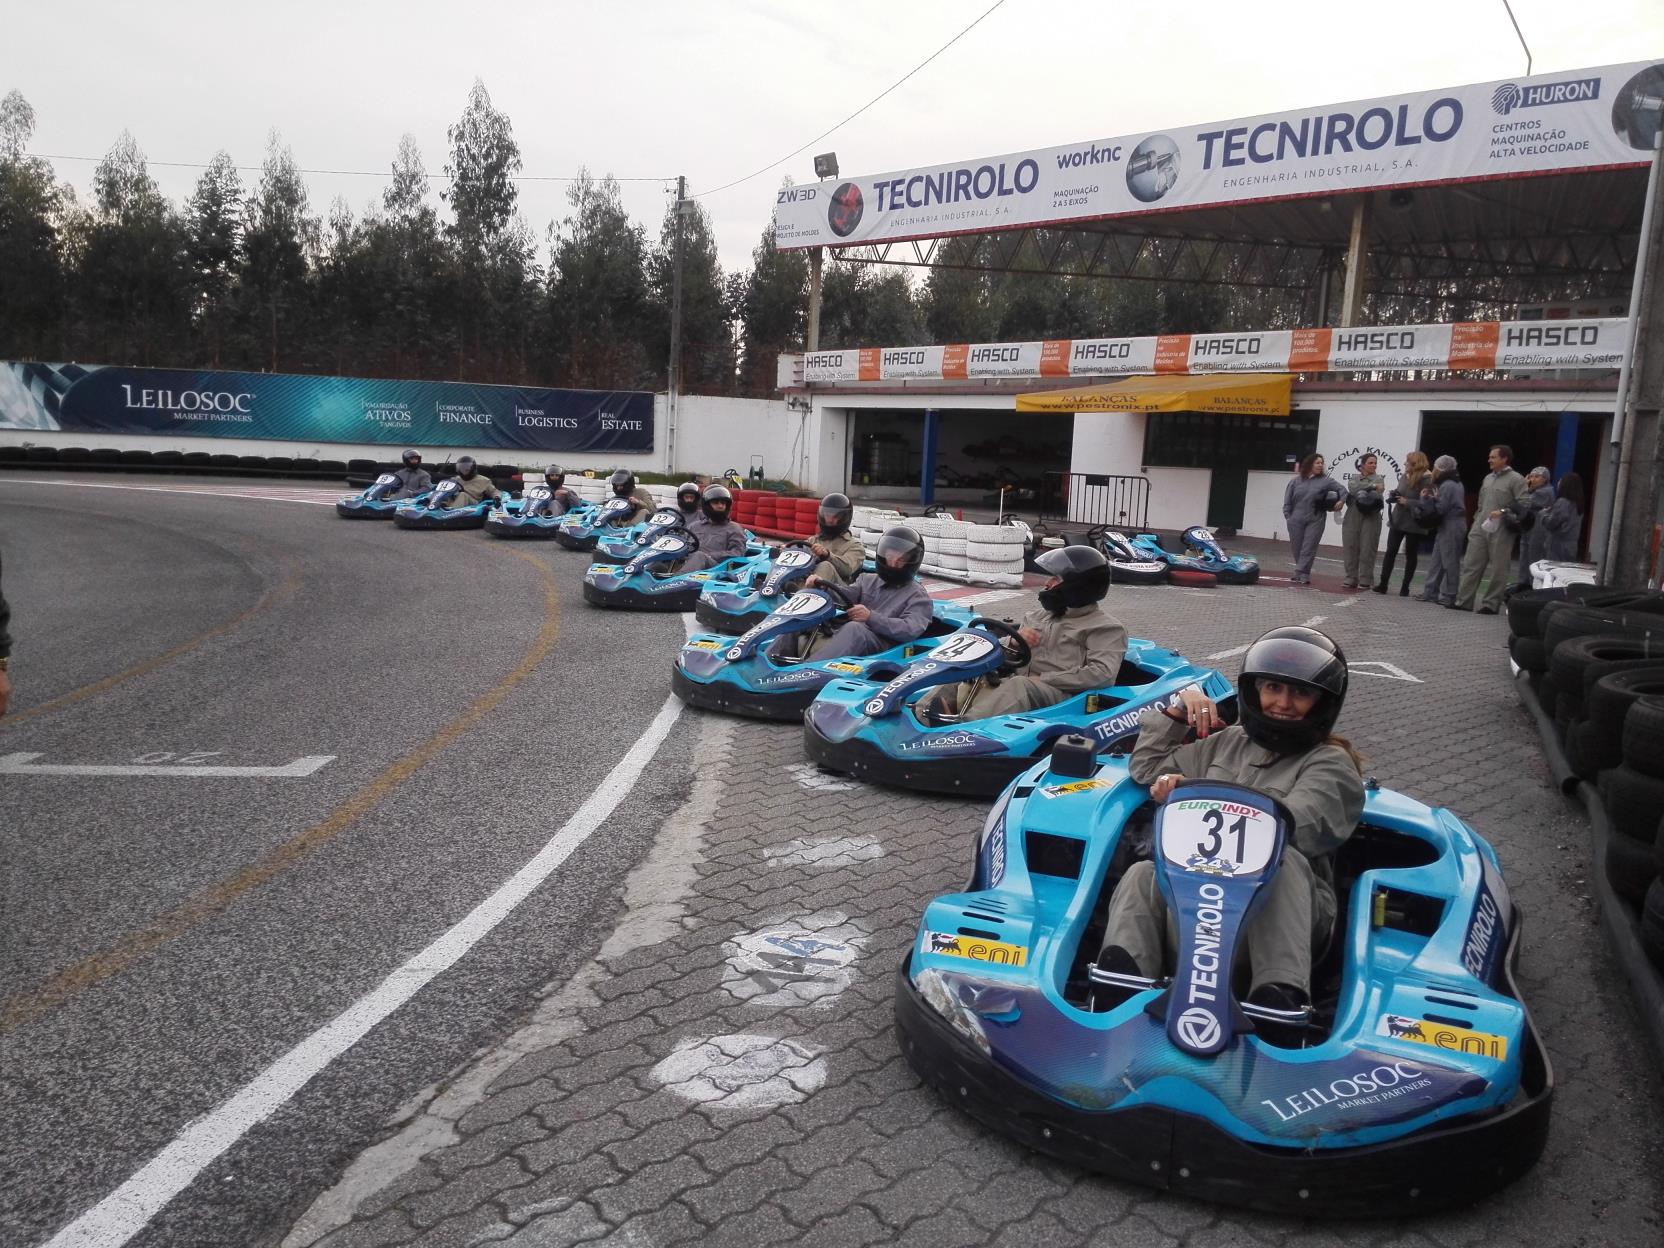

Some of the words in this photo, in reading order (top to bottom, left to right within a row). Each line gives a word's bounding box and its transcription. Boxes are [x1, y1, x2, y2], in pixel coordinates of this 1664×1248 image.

[1527, 81, 1594, 104] HURON
[1197, 97, 1464, 170] TECNIROLO
[1492, 119, 1541, 133] CENTROS
[1491, 129, 1566, 146] MAQUINAÇÃO
[1489, 148, 1516, 159] ALTA
[1518, 140, 1590, 155] VELOCIDADE
[1223, 171, 1298, 188] ENGENHARIA
[1303, 163, 1386, 180] INDUSTRIAL,
[873, 158, 1040, 212] TECNIROLO
[1053, 185, 1099, 198] MAQUINAÇÃO
[777, 188, 817, 204] ZW3D
[1068, 197, 1088, 206] EIXOS
[890, 215, 939, 228] ENGENHARIA
[941, 208, 993, 222] INDUSTRIAL,
[1337, 331, 1415, 352] HASCO
[1506, 326, 1599, 347] HASCO
[971, 347, 1020, 363] HASCO
[1074, 343, 1131, 360] HASCO
[1194, 337, 1262, 356] HASCO
[806, 355, 843, 369] HASCO
[884, 351, 925, 366] HASCO
[1193, 362, 1228, 371] Enabling
[1230, 361, 1248, 370] with
[1335, 357, 1376, 368] Enabling
[1378, 357, 1400, 367] with
[1503, 354, 1553, 366] Enabling
[1555, 354, 1579, 365] with
[1103, 365, 1119, 373] with
[121, 384, 252, 413] LEILOSOC
[364, 410, 411, 421] ATIVOS
[439, 404, 475, 412] CORPORATE
[173, 412, 209, 420] MARKET
[210, 413, 253, 422] PARTNERS
[440, 412, 492, 424] FINANCE
[518, 416, 578, 428] LOGISTICS
[602, 419, 643, 431] ESTATE
[781, 553, 800, 566] 21
[781, 596, 811, 612] 30
[936, 636, 978, 658] 24
[900, 734, 975, 751] LEILOSOC
[1177, 801, 1262, 818] EUROINDY
[1197, 809, 1247, 864] 31
[1188, 883, 1225, 1004] TECNIROLO
[1464, 893, 1497, 978] ECNIROLO
[967, 943, 1022, 967] eni
[1434, 1031, 1500, 1059] eni
[1261, 1062, 1423, 1122] LEILOSOC
[1337, 1094, 1383, 1111] MARKET
[1381, 1078, 1432, 1100] PARTNERS
